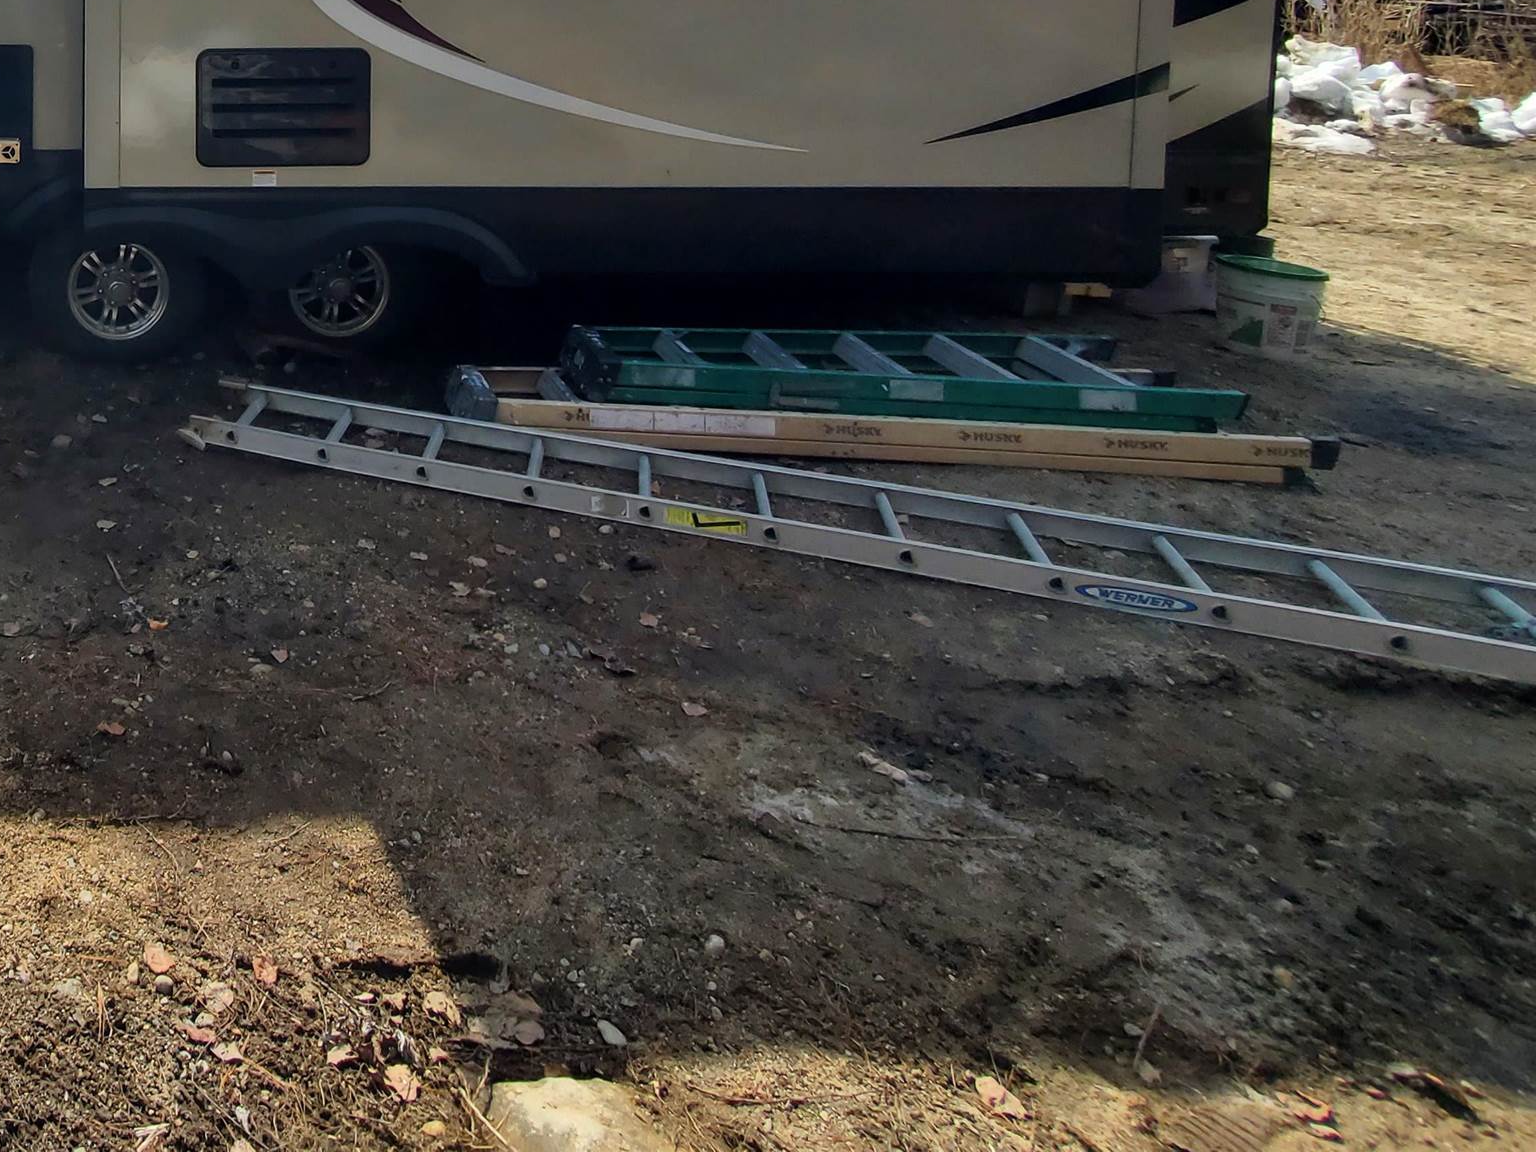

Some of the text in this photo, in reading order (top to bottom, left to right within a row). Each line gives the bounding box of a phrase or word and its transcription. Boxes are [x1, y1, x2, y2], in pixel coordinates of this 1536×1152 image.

[973, 431, 1022, 444] HUSKY
[1117, 437, 1167, 452] HUSKY
[1267, 445, 1311, 459] HUSK
[1098, 588, 1175, 608] WERNER
